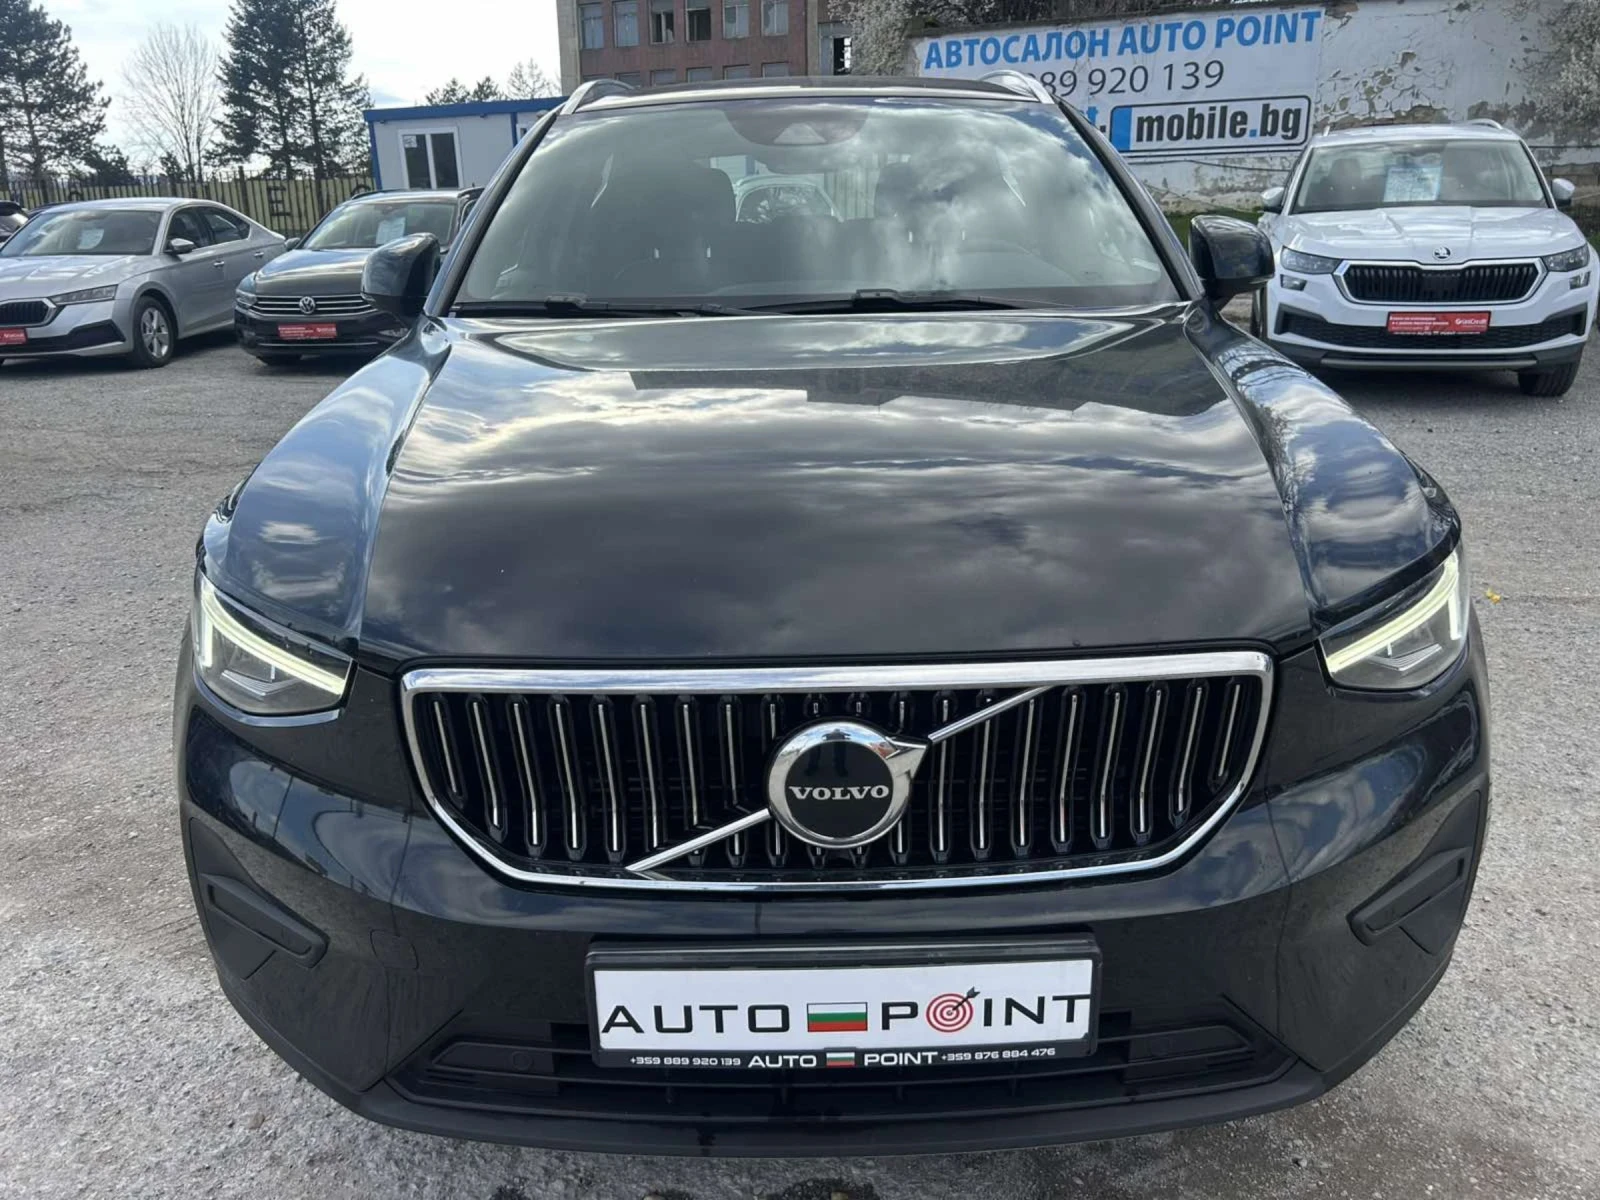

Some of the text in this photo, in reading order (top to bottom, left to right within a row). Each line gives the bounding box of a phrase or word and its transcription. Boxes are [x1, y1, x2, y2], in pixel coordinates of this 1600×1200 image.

[924, 11, 1321, 69] АВТОСАЛОН AUTO POINT
[1088, 64, 1149, 96] 920
[1163, 60, 1225, 91] 139
[1135, 103, 1302, 143] mobile.bg
[789, 785, 890, 800] VOLVO
[601, 1004, 790, 1034] AUTO
[630, 1056, 660, 1065] +359
[692, 1057, 718, 1066] 920
[720, 1057, 741, 1066] 139
[748, 1055, 817, 1068] AUTO
[864, 1051, 938, 1066] POINT
[941, 1052, 972, 1061] +359
[974, 1050, 999, 1060] 876
[1002, 1049, 1028, 1058] 884
[1031, 1048, 1056, 1056] 476
